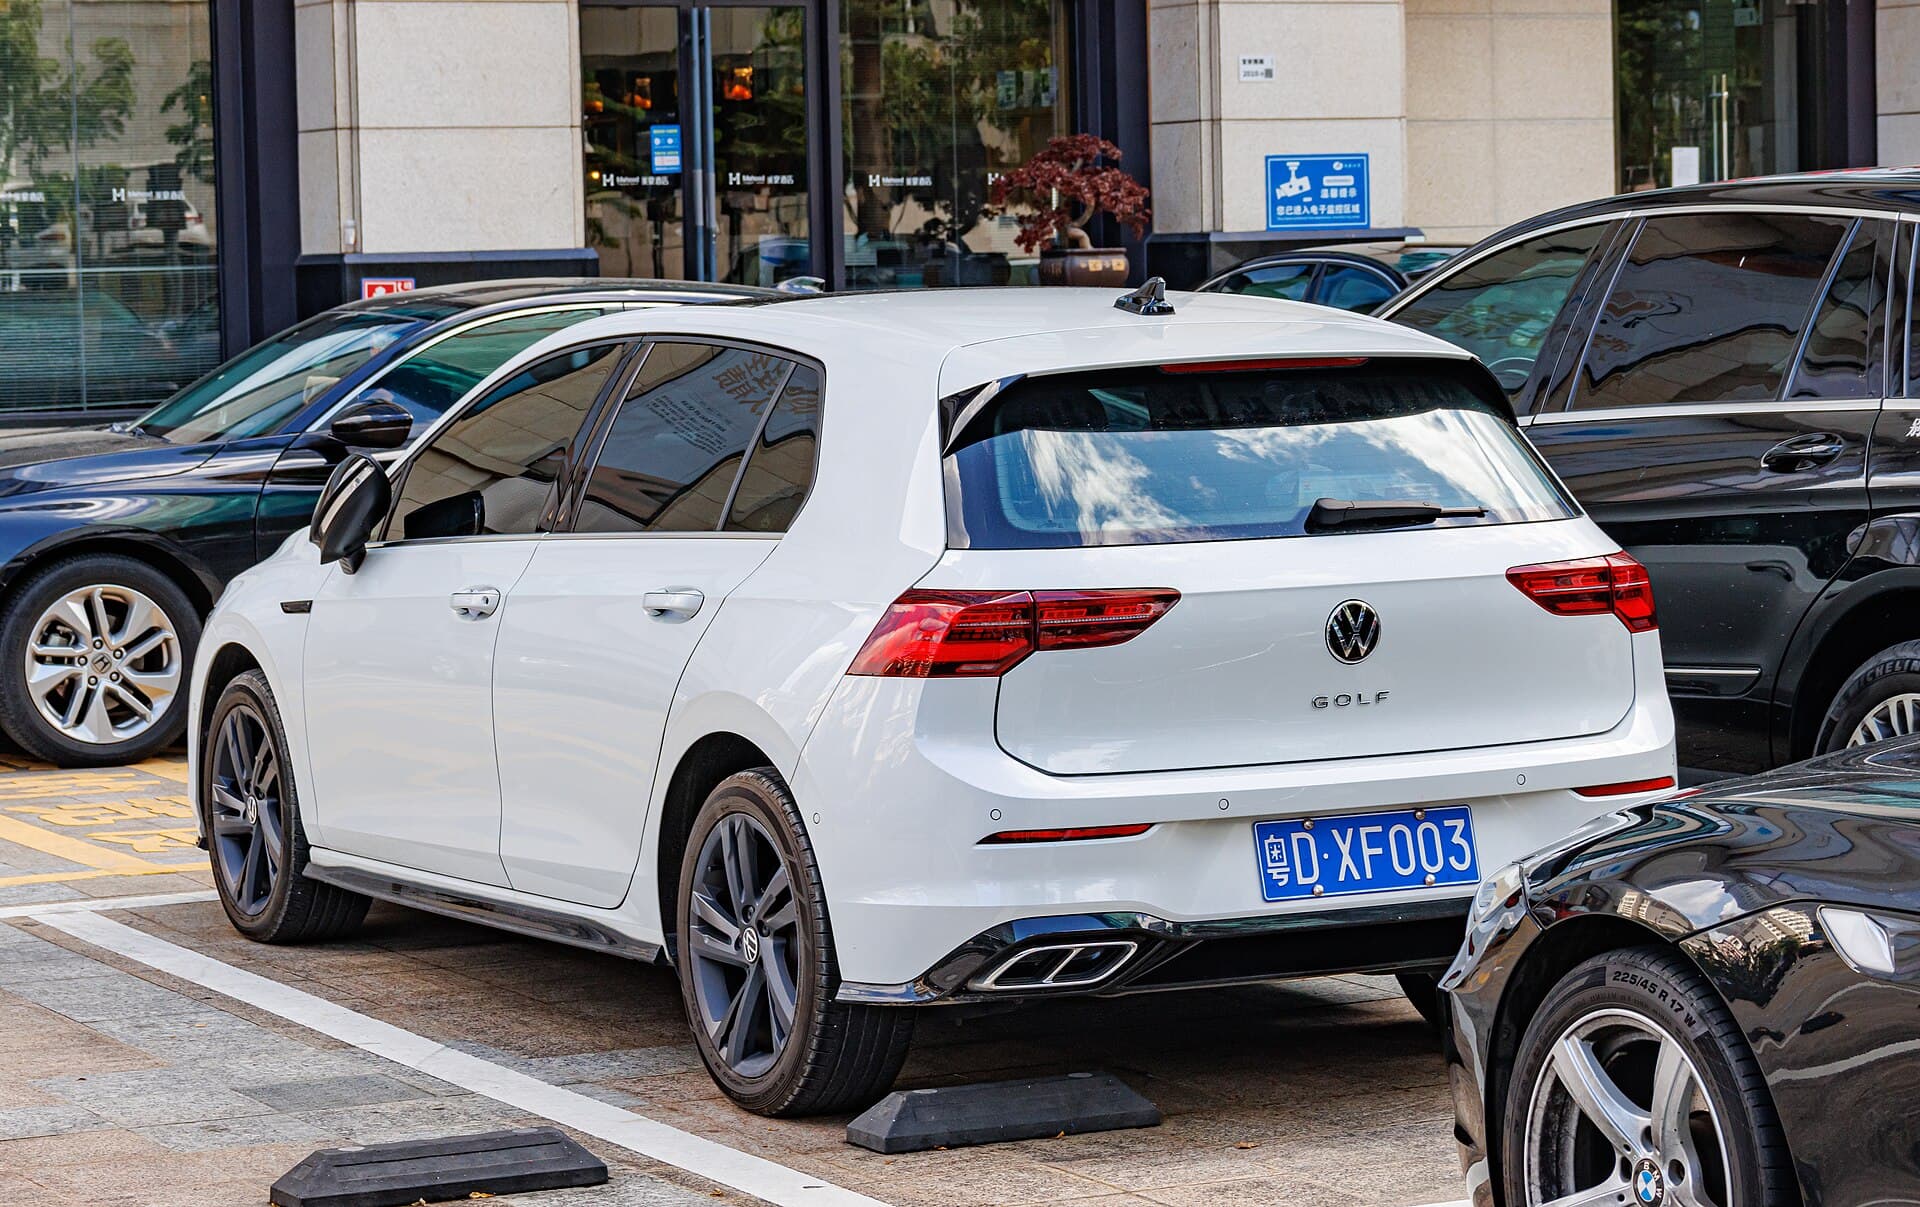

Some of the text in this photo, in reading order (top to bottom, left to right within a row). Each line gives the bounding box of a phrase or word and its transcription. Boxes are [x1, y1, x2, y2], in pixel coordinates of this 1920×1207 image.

[1312, 690, 1390, 709] GOLF
[1612, 970, 1658, 994] 225/45
[1658, 988, 1669, 1002] R
[1669, 998, 1685, 1013] 17
[1684, 1012, 1697, 1028] W
